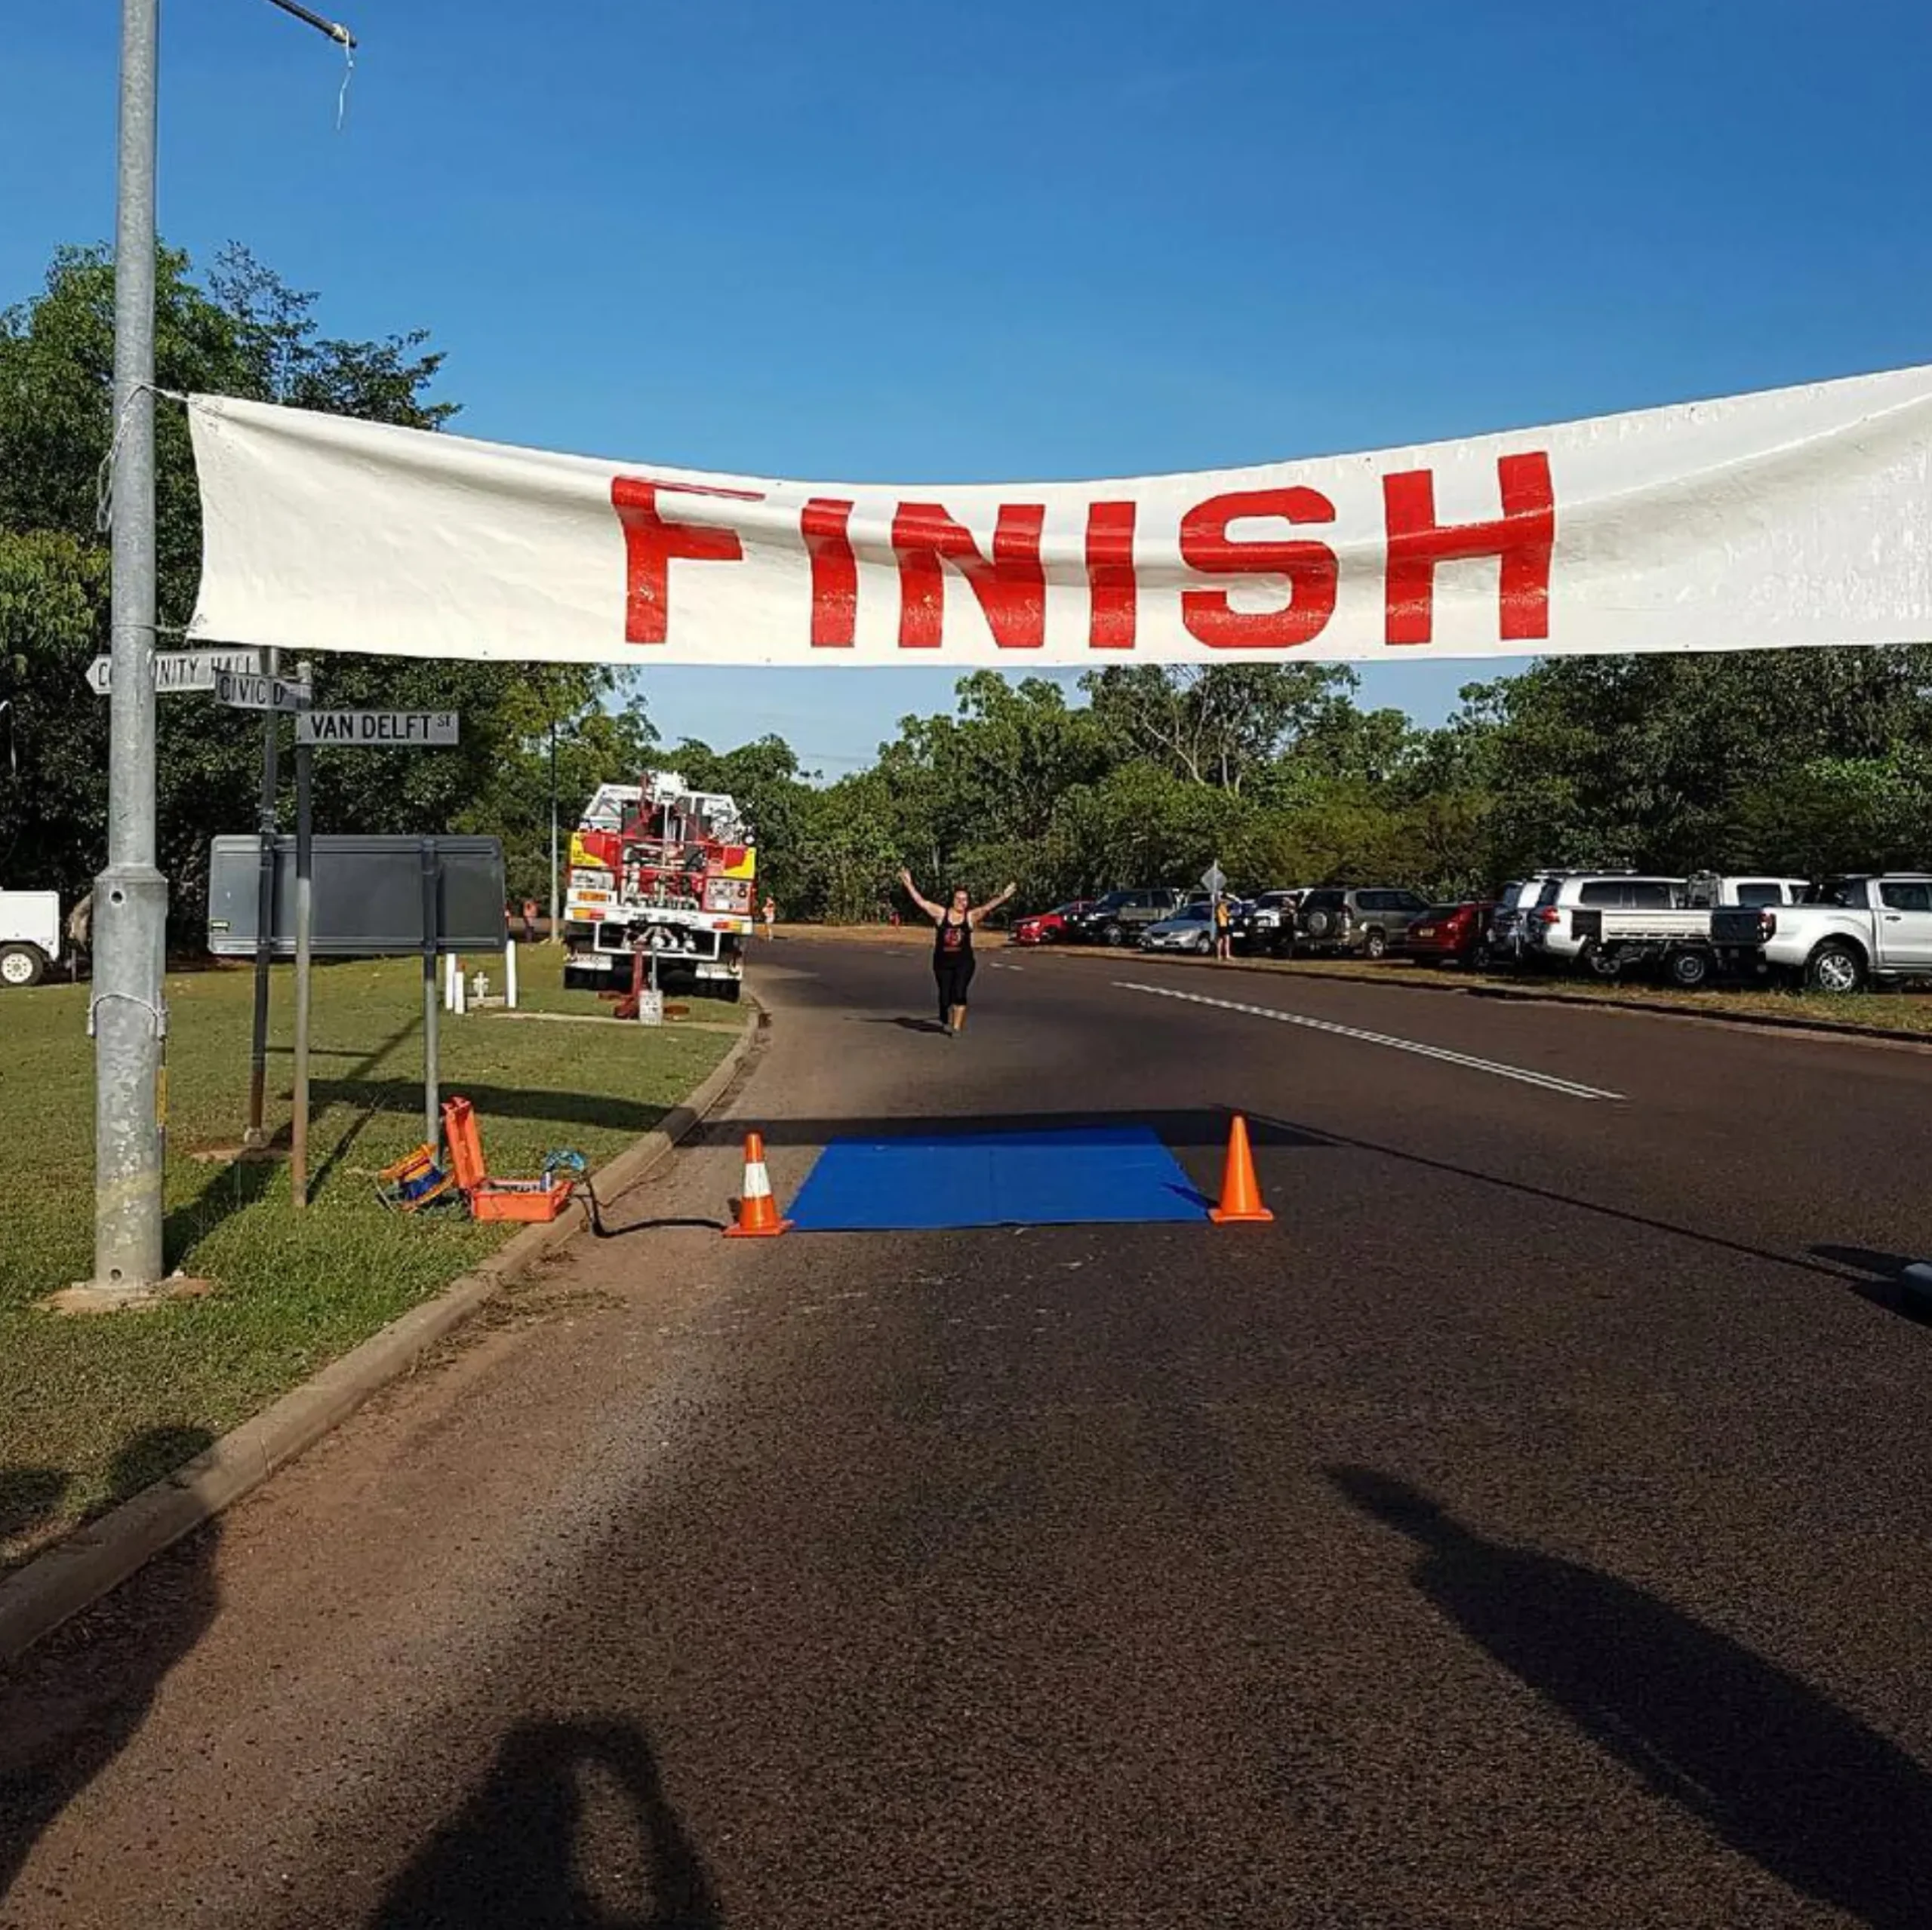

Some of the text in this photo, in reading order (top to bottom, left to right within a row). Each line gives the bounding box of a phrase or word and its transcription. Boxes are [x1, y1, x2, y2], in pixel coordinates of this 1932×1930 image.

[611, 450, 1555, 650] FINISH
[220, 676, 266, 704] CIVIC
[311, 715, 354, 739] VAN
[362, 715, 431, 739] DELFT
